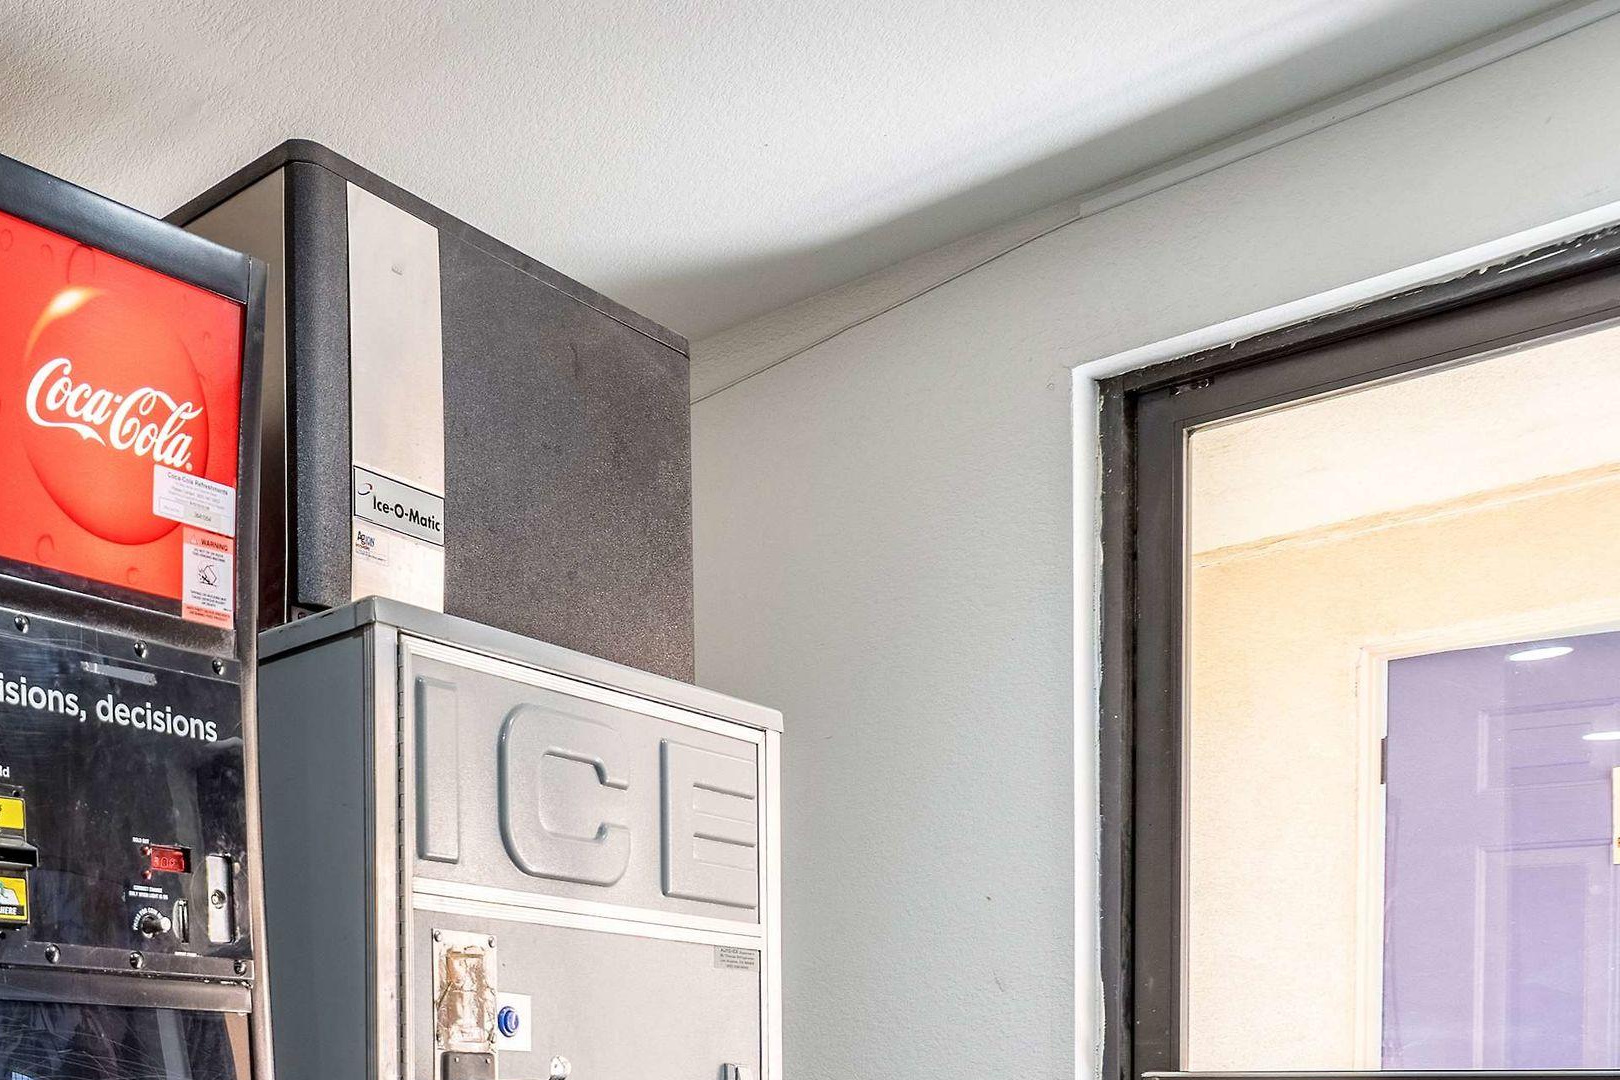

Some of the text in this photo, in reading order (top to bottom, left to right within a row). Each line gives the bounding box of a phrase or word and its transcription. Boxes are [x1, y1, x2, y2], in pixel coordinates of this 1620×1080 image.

[26, 358, 202, 469] Coca-Cola
[373, 495, 441, 531] Ice-O-Matic
[200, 538, 228, 551] WARNING
[96, 694, 218, 742] decisions
[415, 676, 757, 909] ICE
[0, 906, 17, 915] HERE
